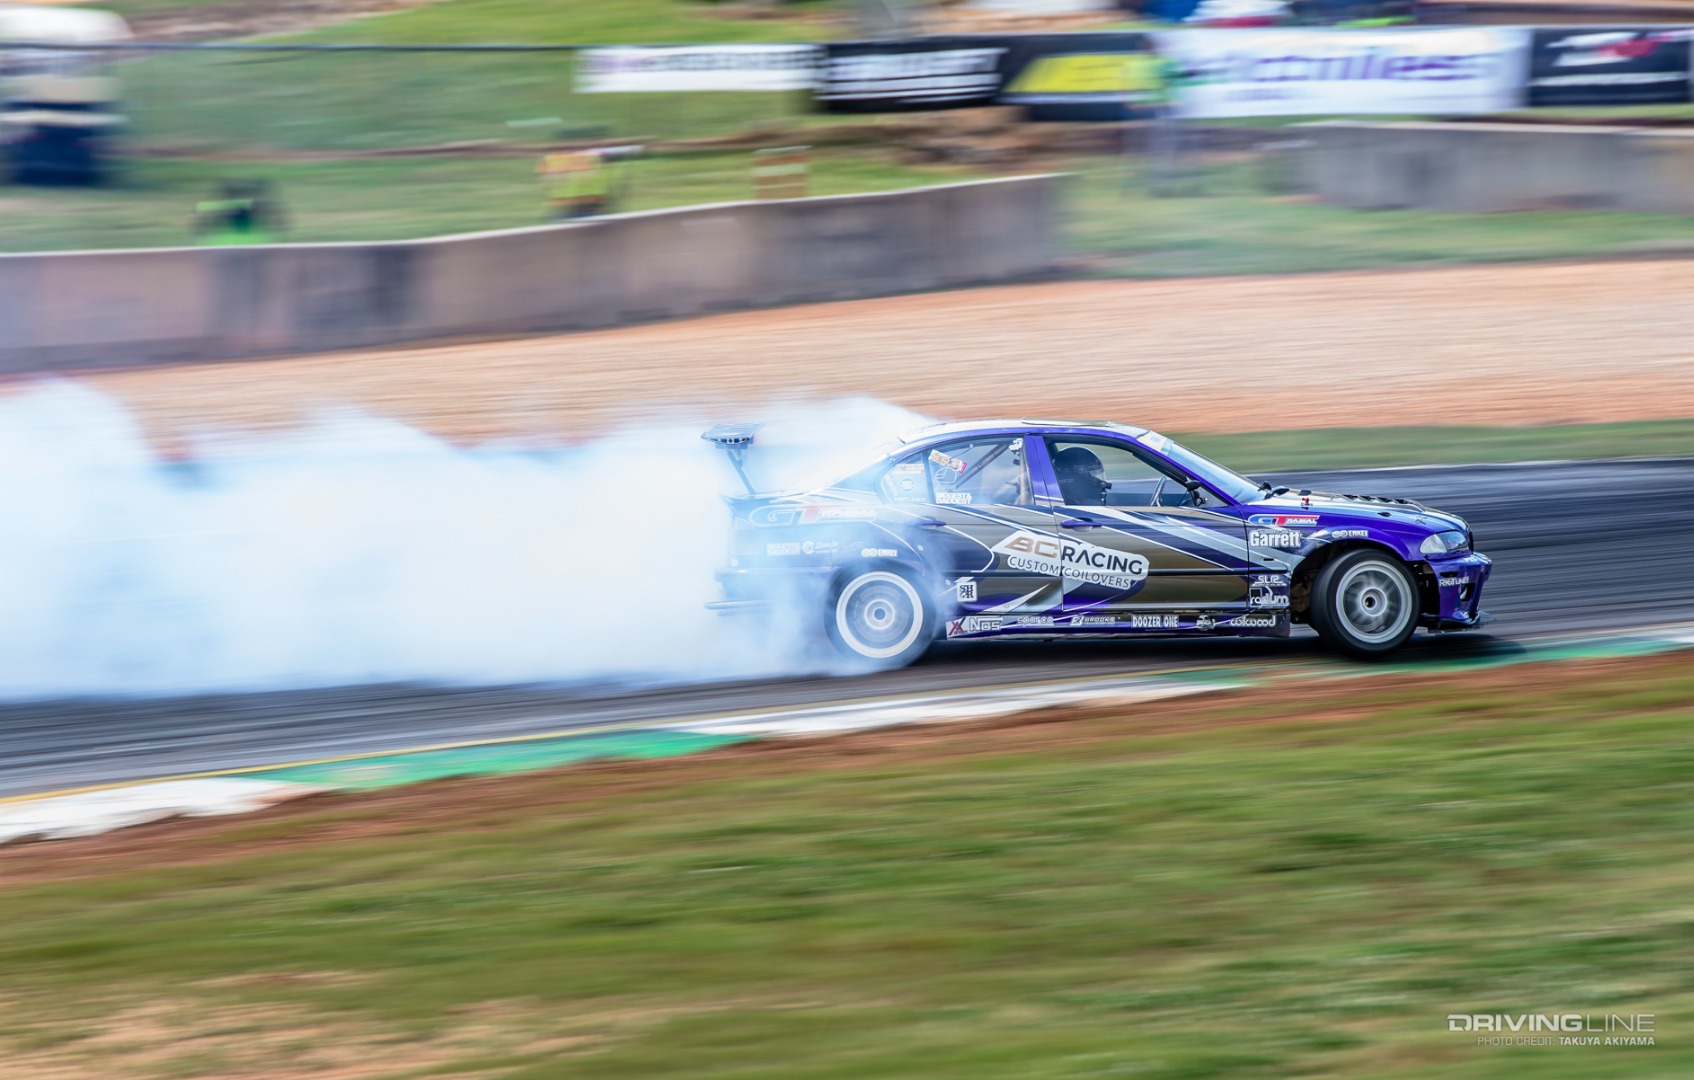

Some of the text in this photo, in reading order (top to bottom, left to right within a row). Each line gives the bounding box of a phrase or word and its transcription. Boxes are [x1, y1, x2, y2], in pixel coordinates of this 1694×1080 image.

[1250, 531, 1301, 548] Garrett
[1004, 536, 1143, 575] BC RACING
[1009, 556, 1130, 588] CUSTOM COILOVERS
[1017, 616, 1054, 626] sparco
[1132, 615, 1178, 628] DOOZER ONE
[1229, 615, 1277, 627] wilwood
